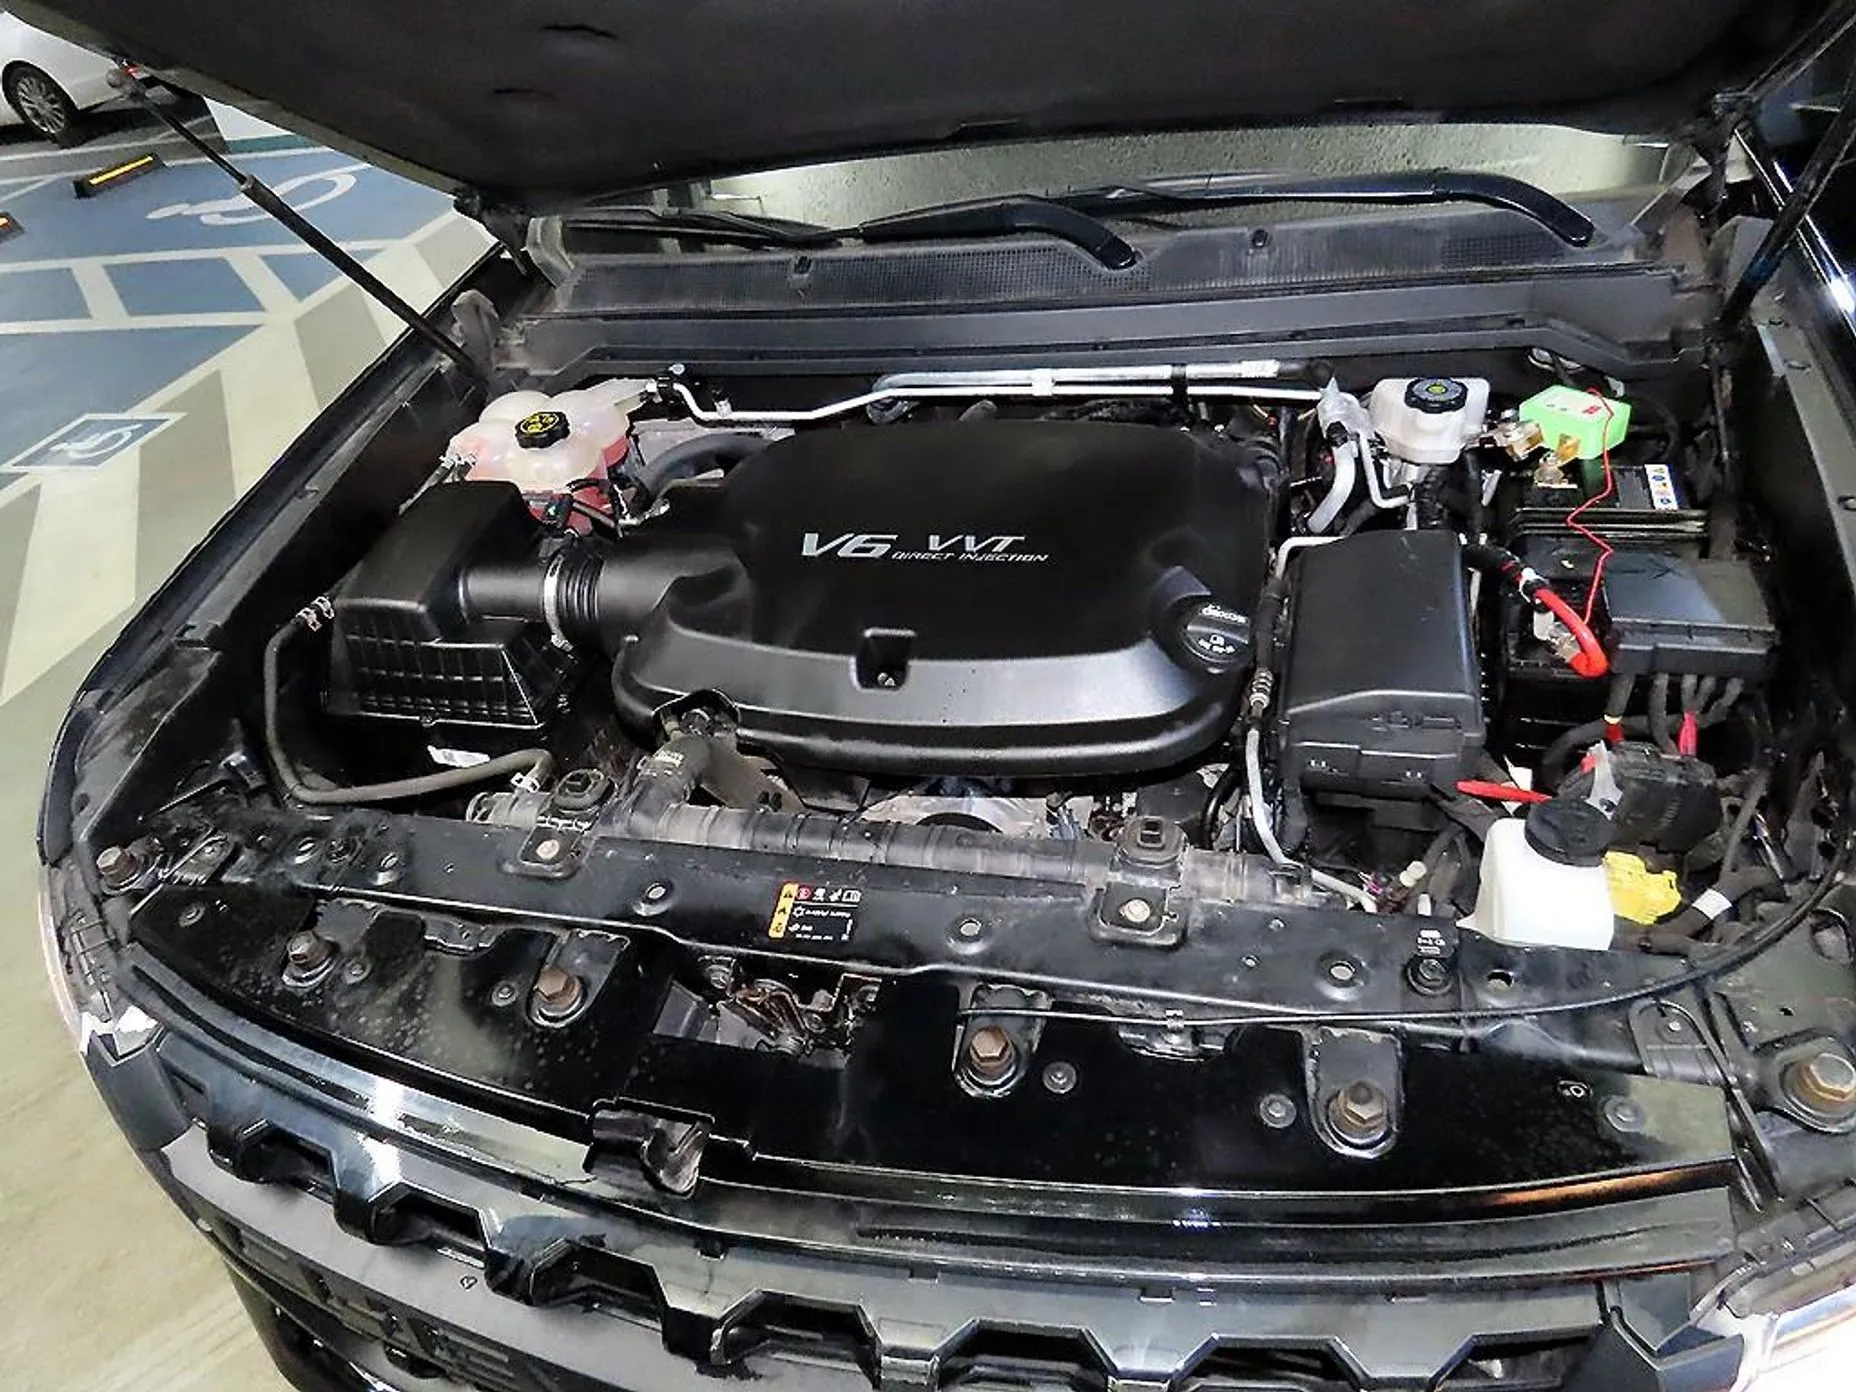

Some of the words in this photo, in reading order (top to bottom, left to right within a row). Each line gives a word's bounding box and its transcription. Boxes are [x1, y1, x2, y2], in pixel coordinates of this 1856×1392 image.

[801, 532, 898, 558] V6
[928, 534, 1025, 553] VVT
[891, 551, 955, 560] DIRECT
[958, 552, 1049, 562] INJECTION
